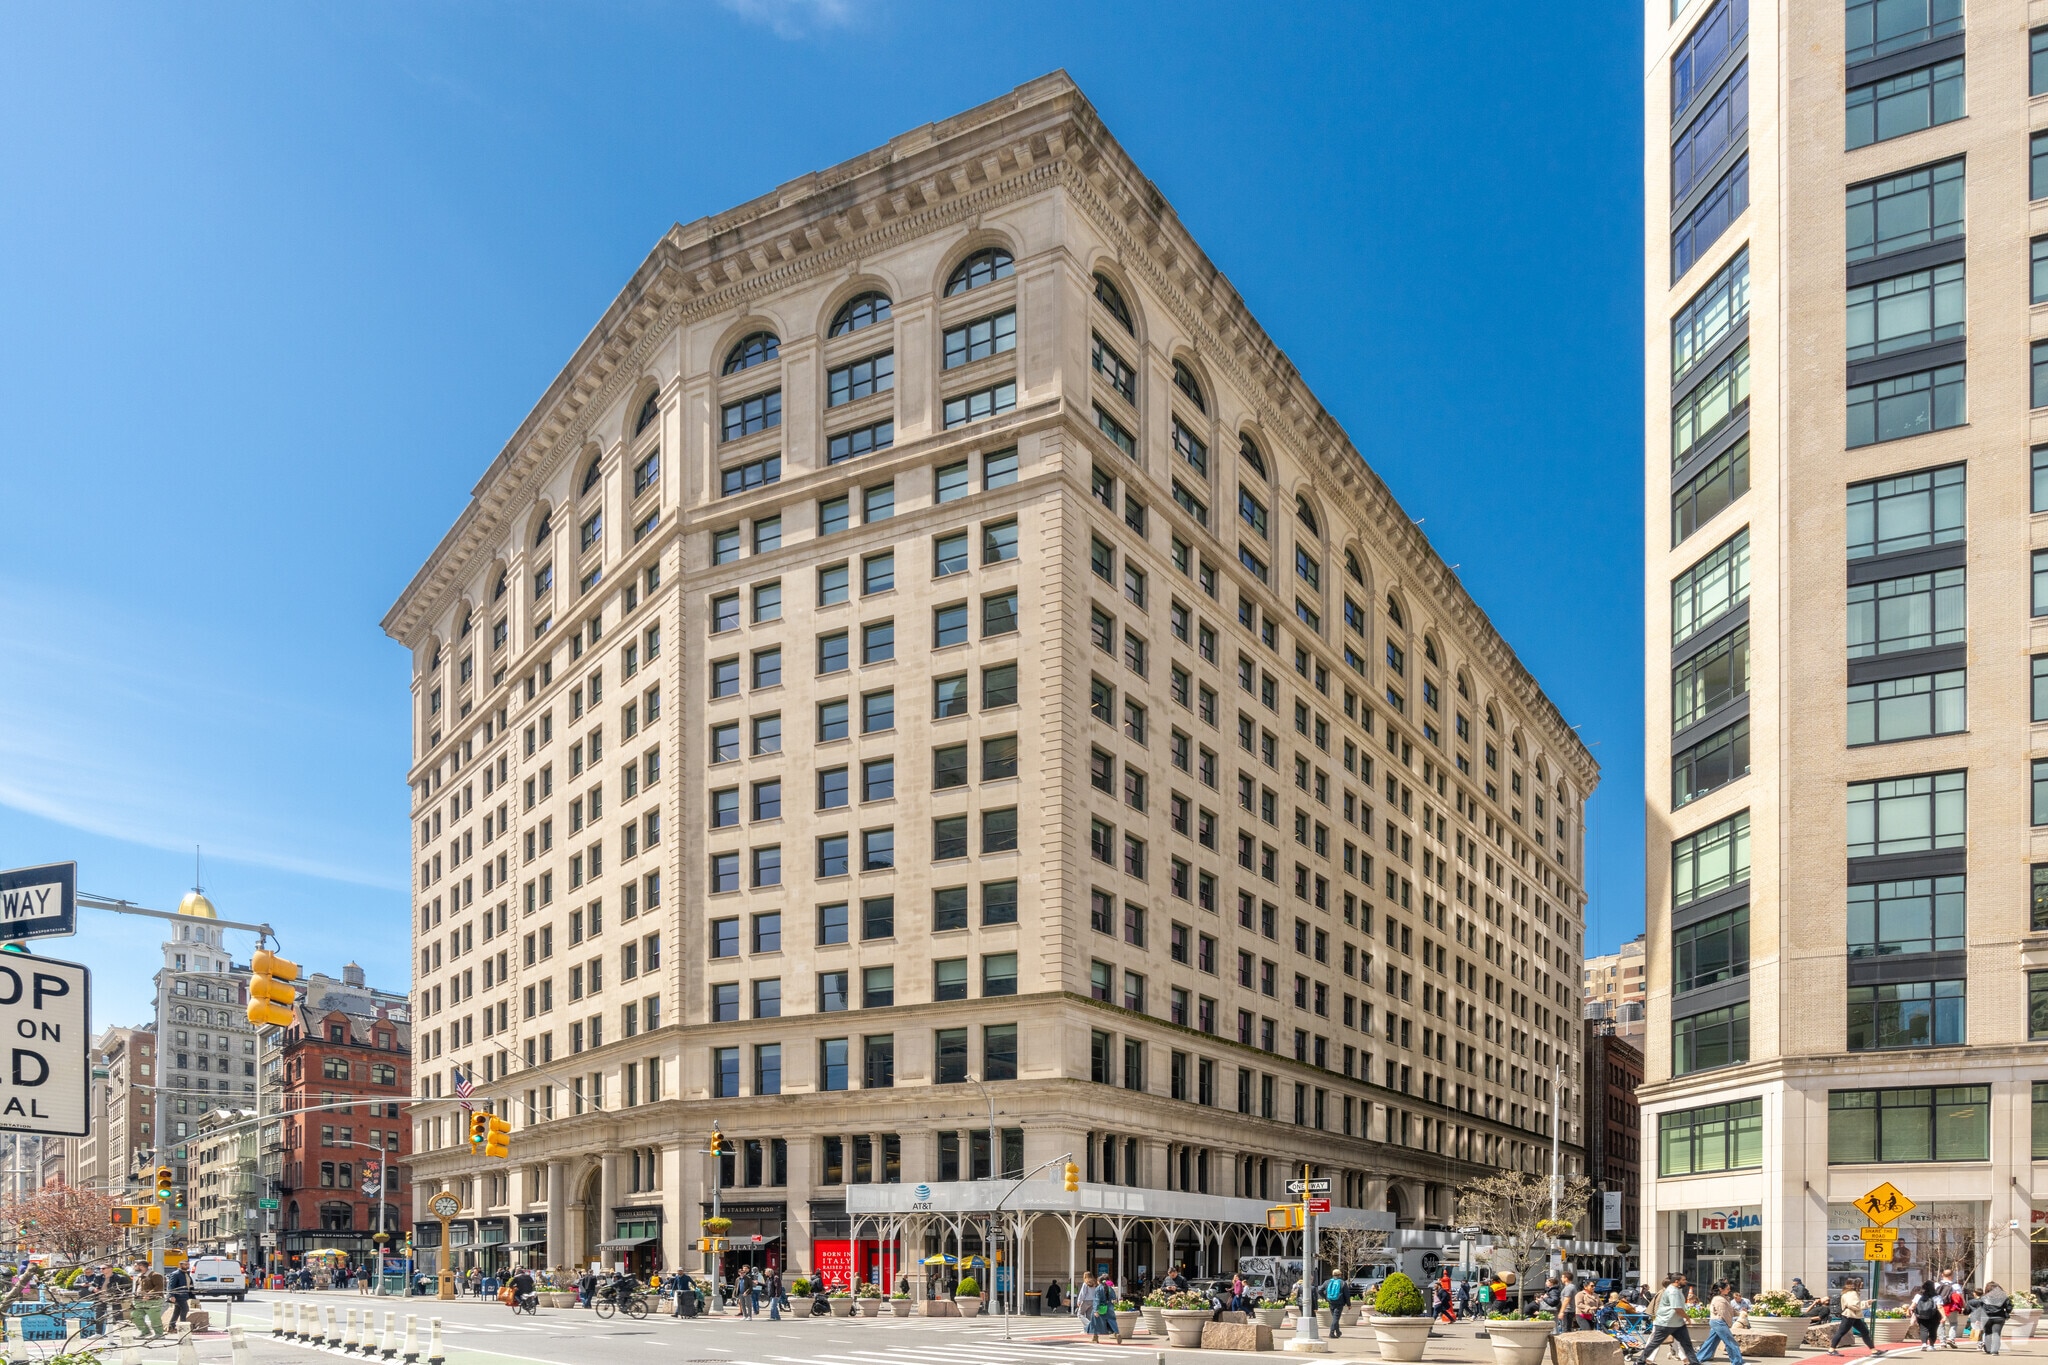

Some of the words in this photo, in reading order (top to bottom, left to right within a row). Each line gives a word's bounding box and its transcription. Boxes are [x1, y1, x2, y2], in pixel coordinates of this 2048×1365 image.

[3, 887, 52, 920] WAY
[17, 1018, 61, 1043] ON
[0, 1048, 50, 1087] D
[3, 1096, 49, 1119] AL
[912, 1202, 933, 1210] AT&T
[1874, 1243, 1884, 1253] 5
[822, 1271, 852, 1279] NYC
[28, 1330, 52, 1340] THE
